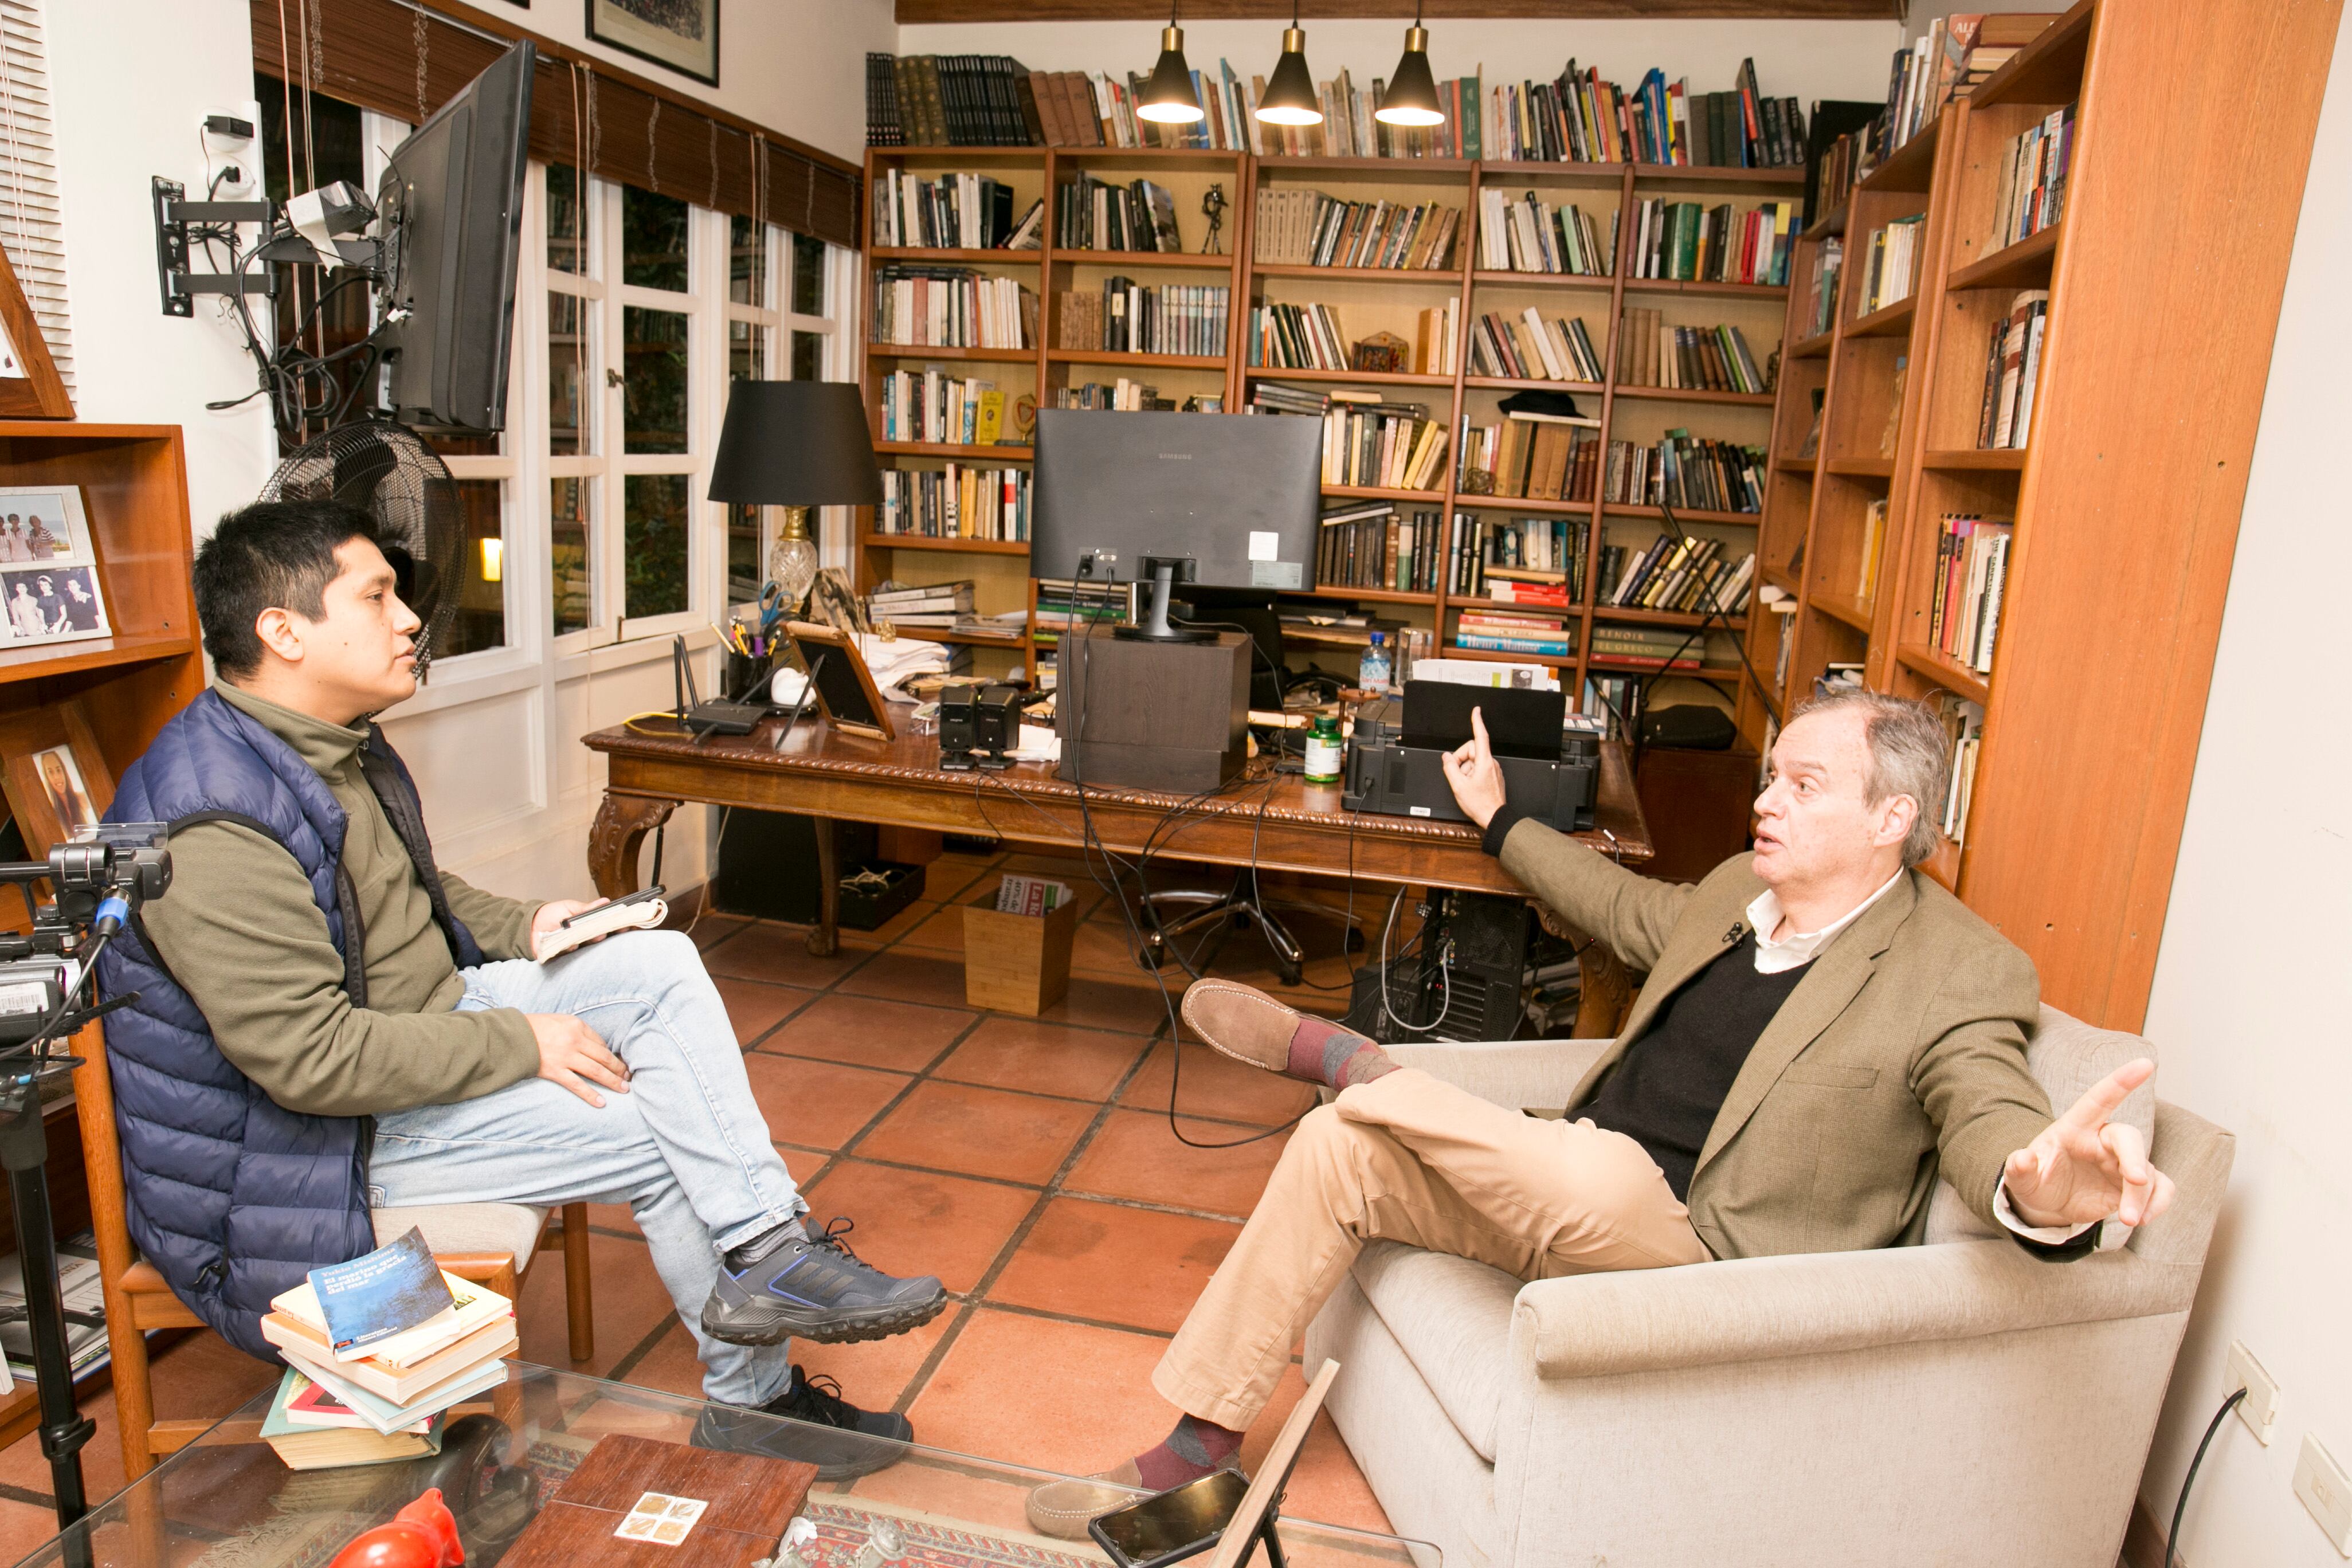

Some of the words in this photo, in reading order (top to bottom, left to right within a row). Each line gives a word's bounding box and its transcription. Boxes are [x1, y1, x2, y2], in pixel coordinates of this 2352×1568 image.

[1598, 629, 1645, 641] RENOIR
[1598, 641, 1610, 650] EL
[1614, 643, 1653, 653] GRECO
[1014, 880, 1022, 897] 40%
[1032, 885, 1042, 900] La
[1010, 899, 1019, 911] de
[321, 1267, 351, 1277] Yukio
[353, 1248, 396, 1269] Mishima
[323, 1277, 336, 1285] El
[338, 1264, 378, 1282] marino
[379, 1254, 399, 1268] que
[325, 1275, 362, 1291] perdió
[363, 1271, 374, 1279] la
[375, 1255, 408, 1275] gracia
[327, 1287, 345, 1296] del
[347, 1278, 370, 1290] mar
[356, 1327, 388, 1341] Literatura
